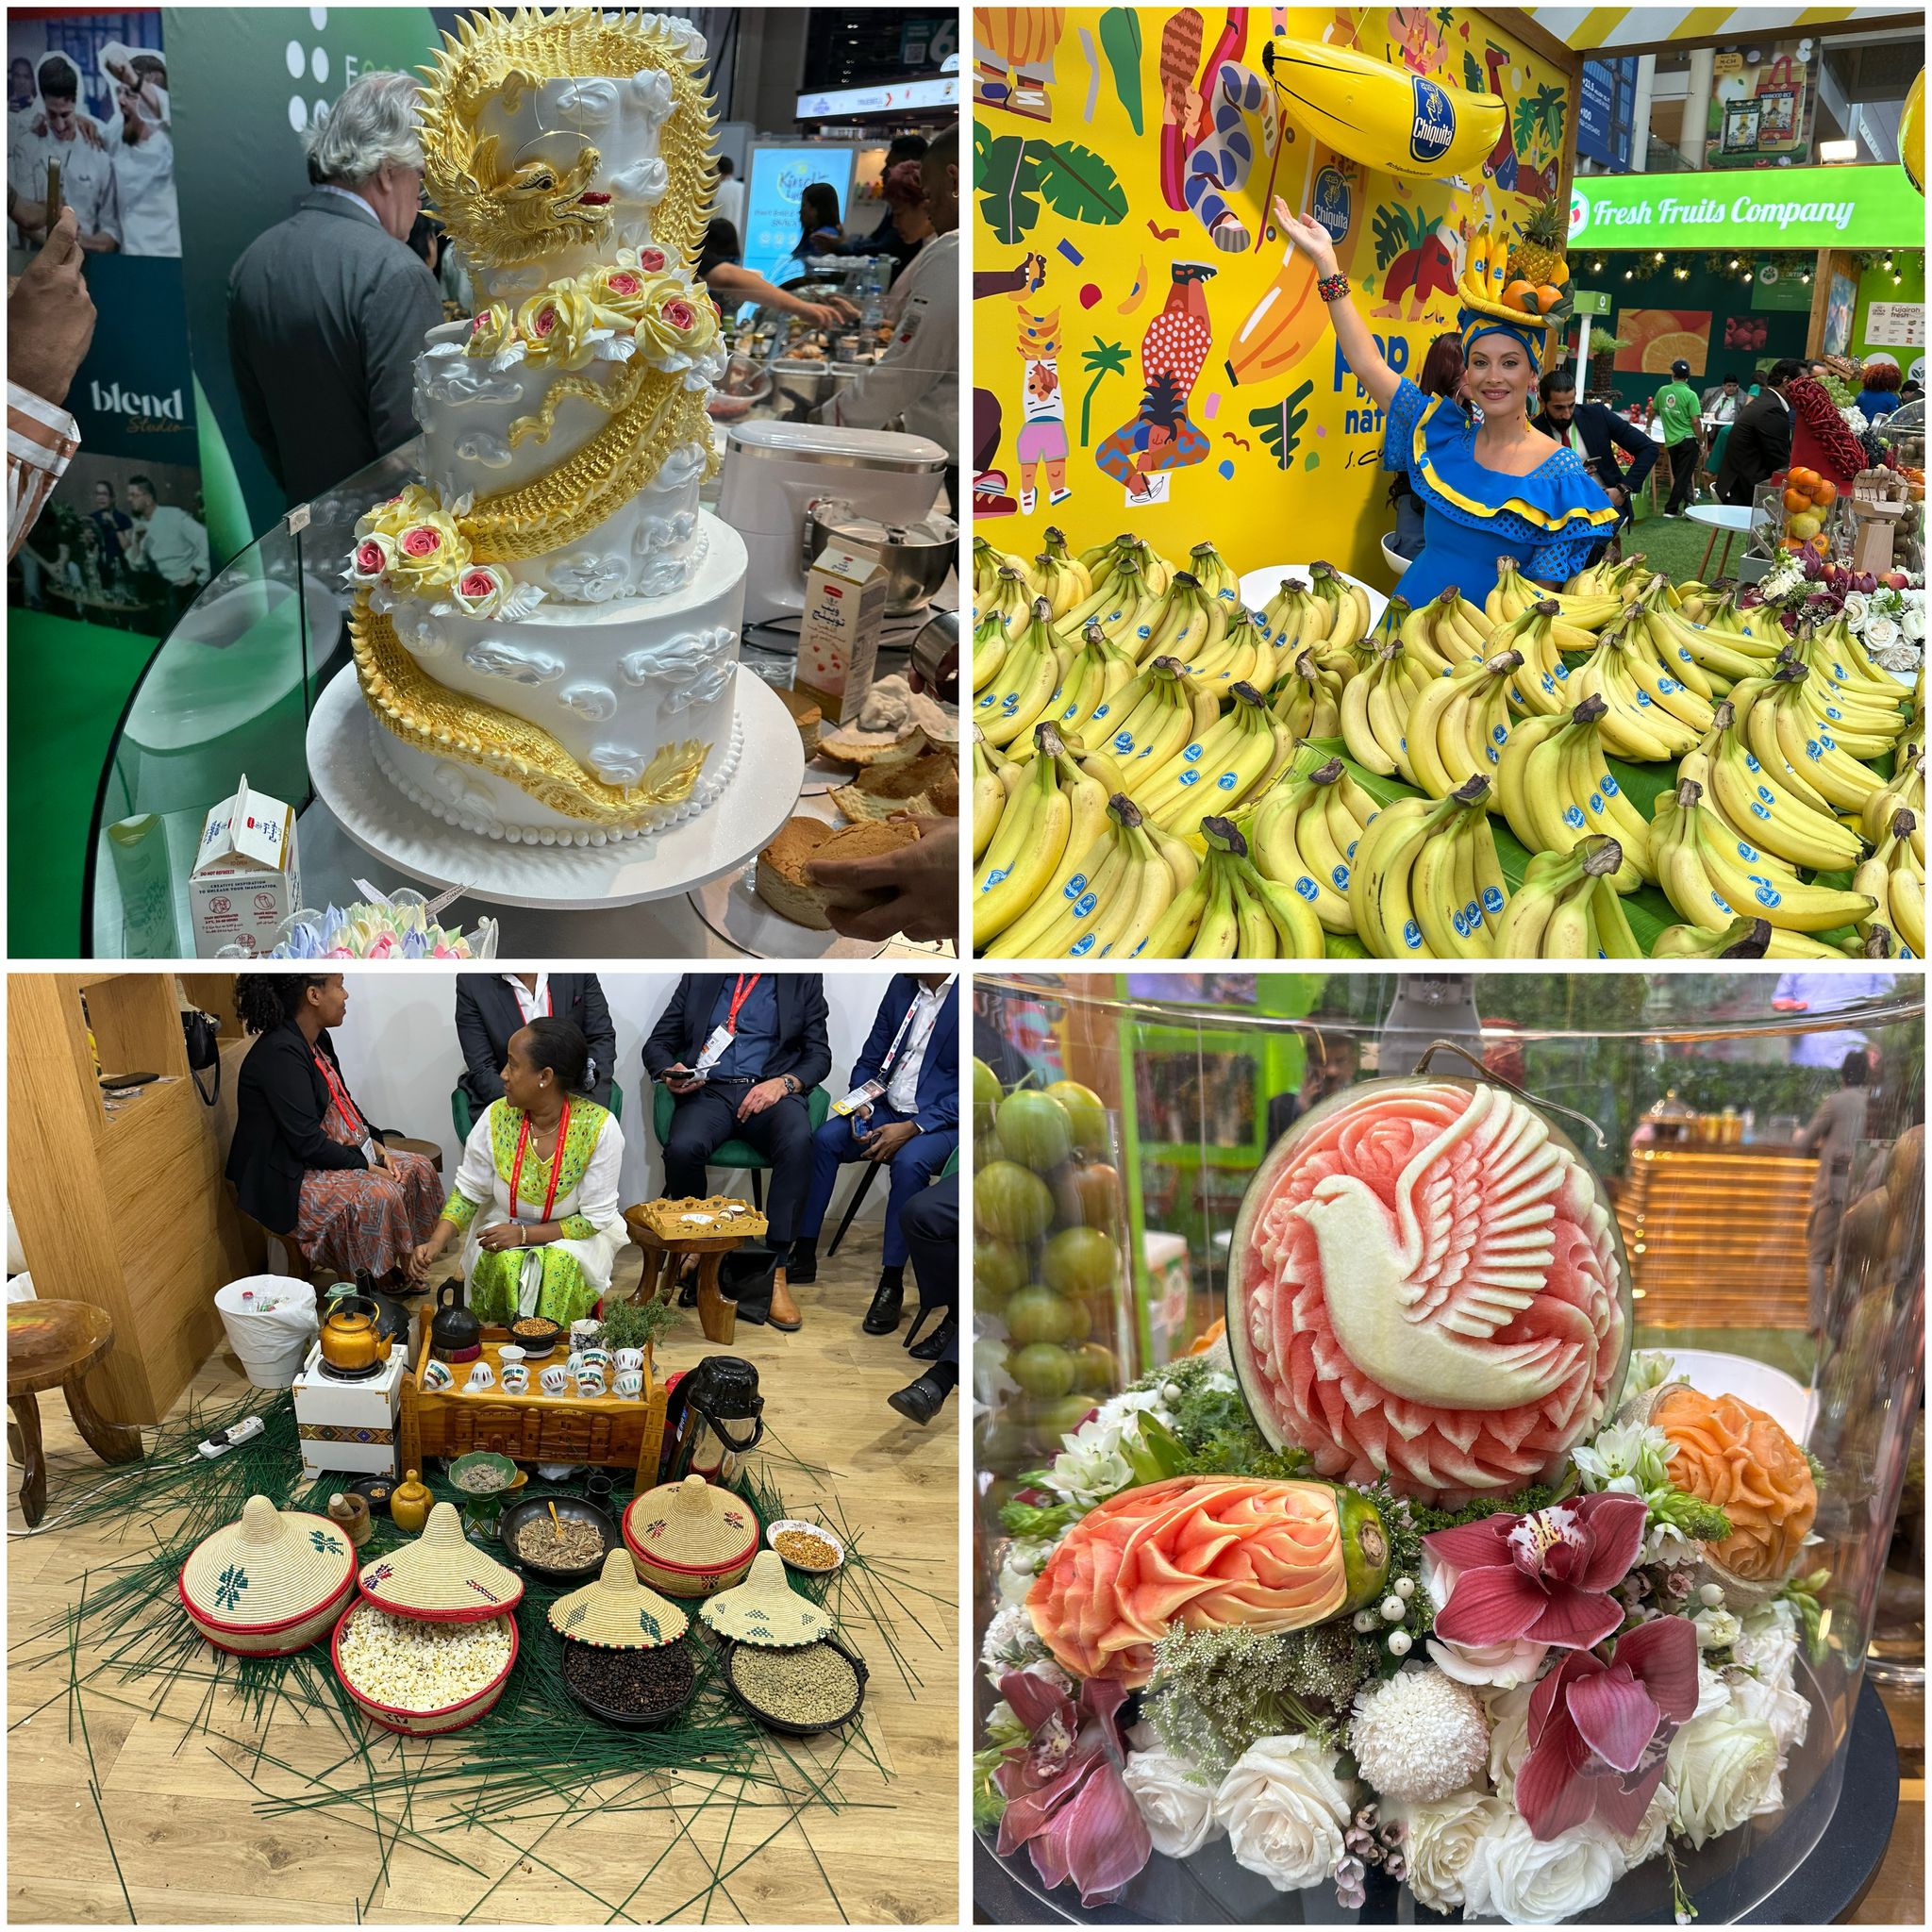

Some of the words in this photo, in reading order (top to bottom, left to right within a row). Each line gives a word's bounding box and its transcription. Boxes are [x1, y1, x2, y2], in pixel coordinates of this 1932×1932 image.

[1413, 116, 1454, 148] Chiquita
[1314, 204, 1348, 231] Chiquita
[1593, 199, 1652, 225] Fresh
[1657, 198, 1725, 225] Fruits
[1731, 195, 1856, 230] Company
[91, 379, 183, 421] blend
